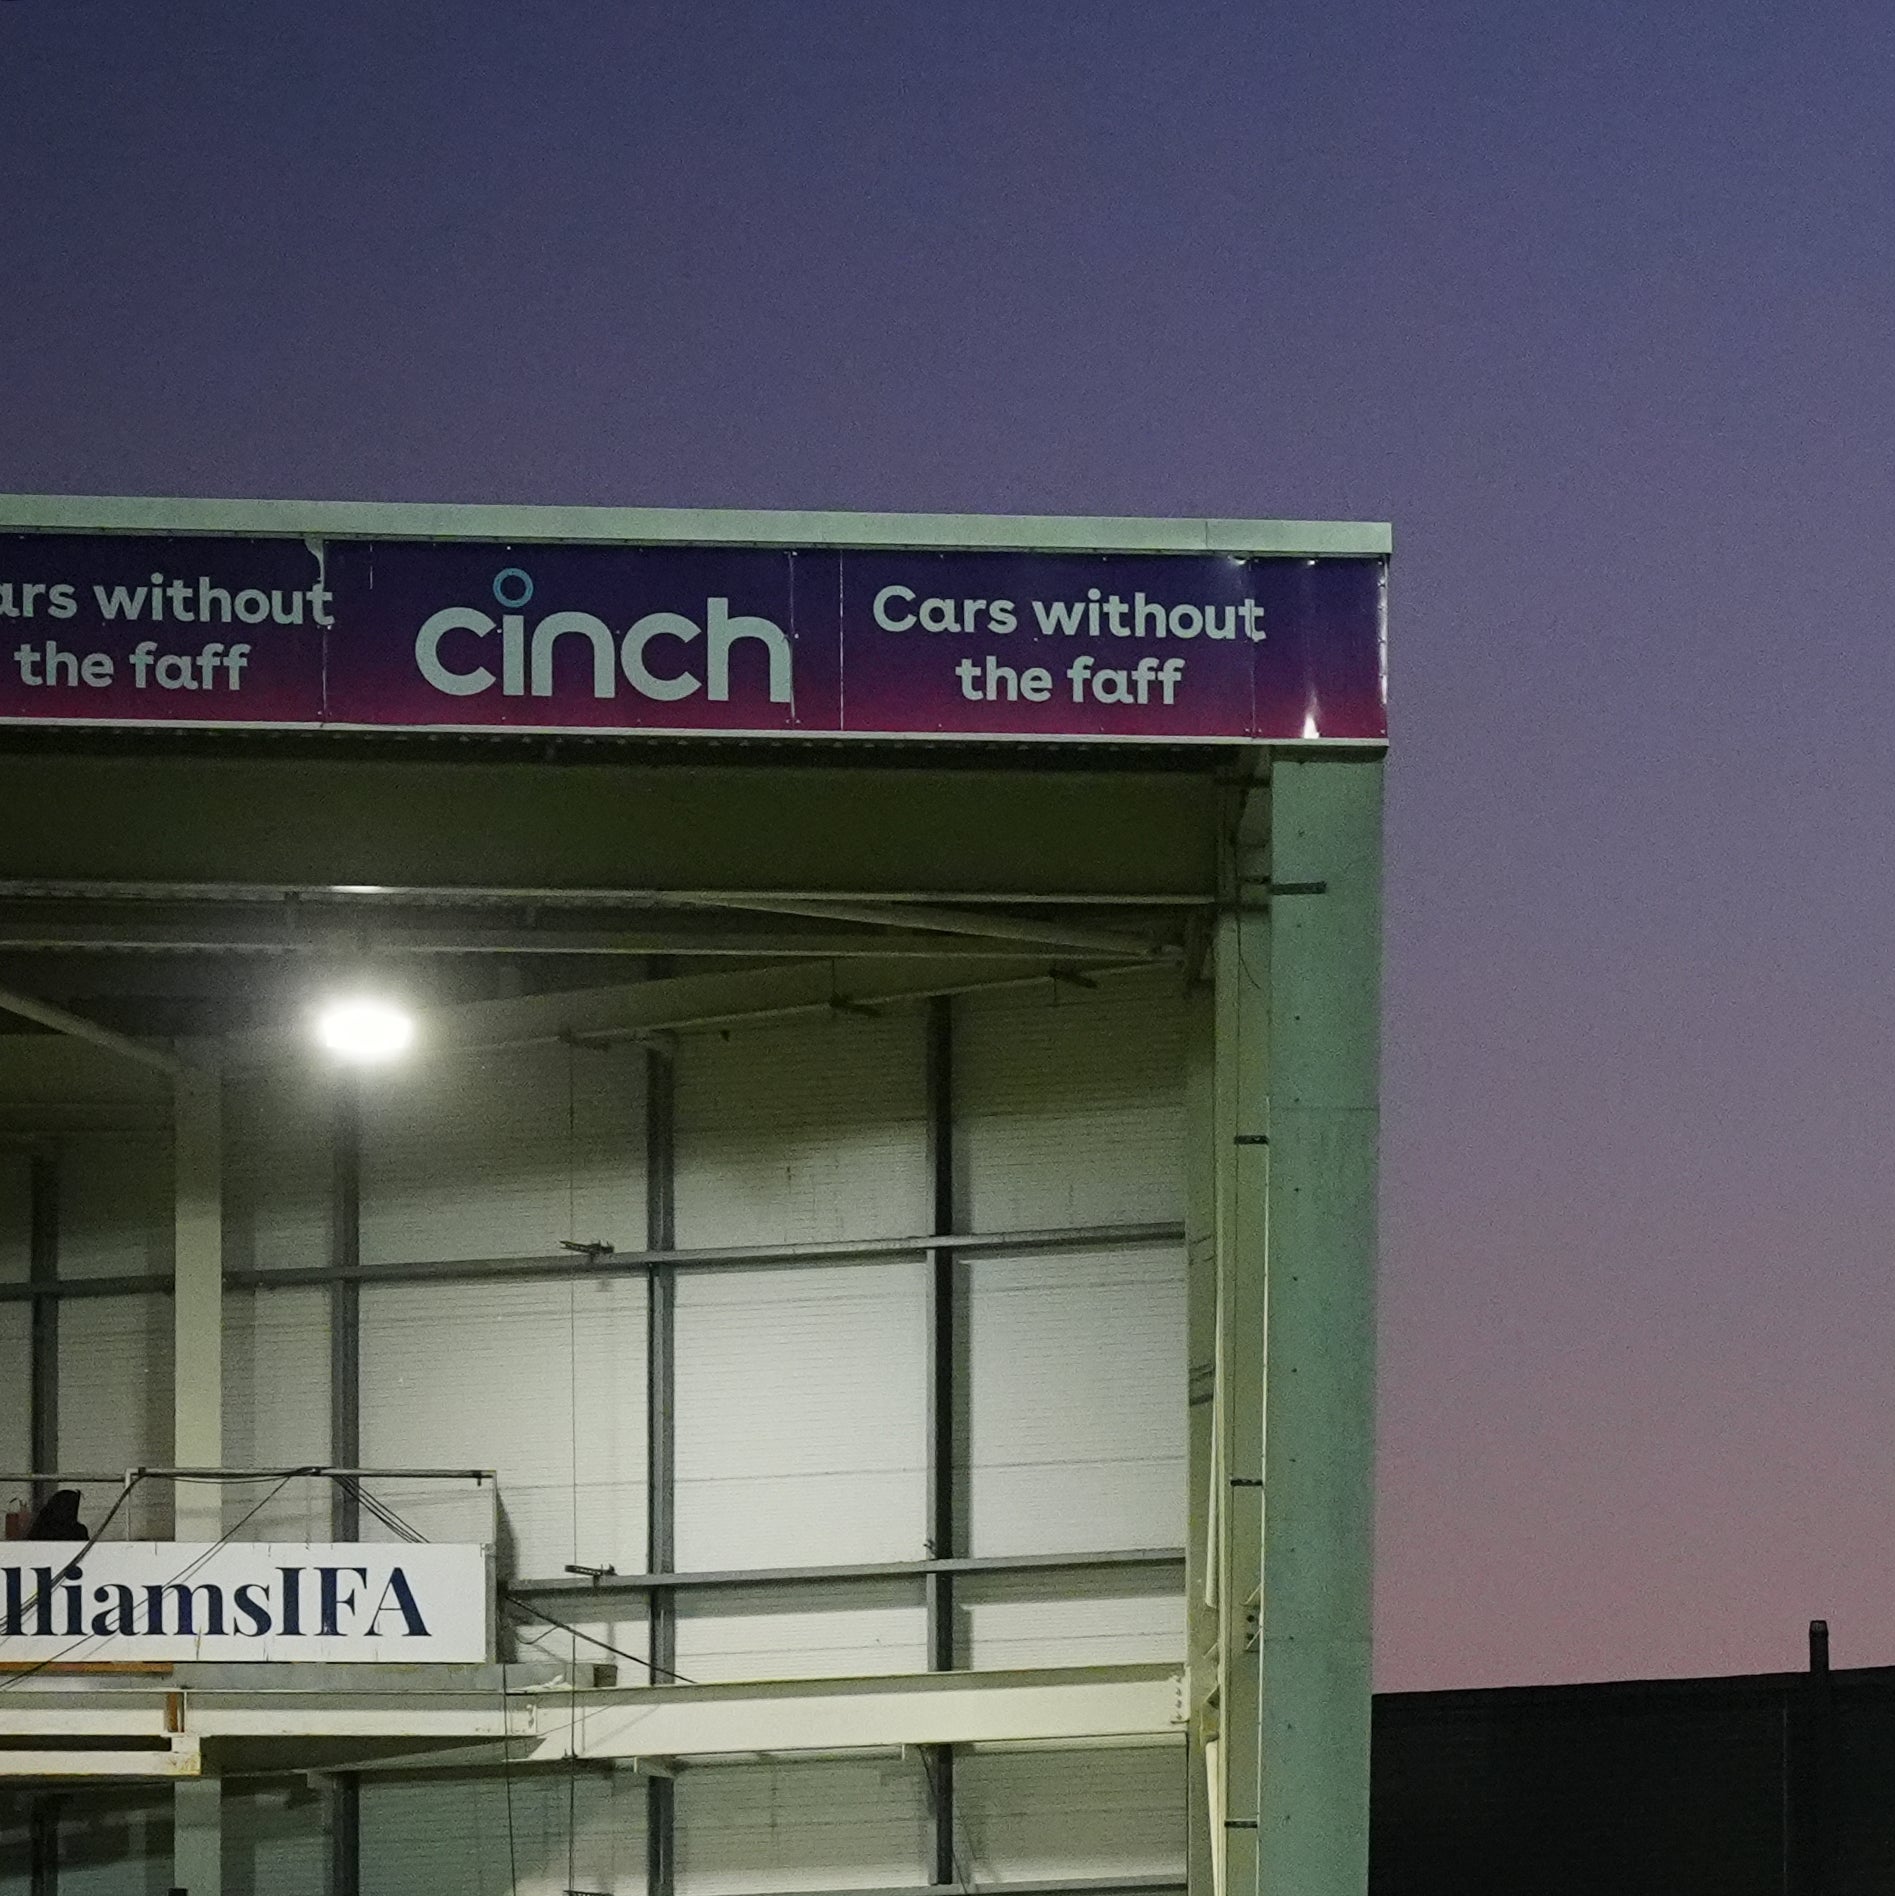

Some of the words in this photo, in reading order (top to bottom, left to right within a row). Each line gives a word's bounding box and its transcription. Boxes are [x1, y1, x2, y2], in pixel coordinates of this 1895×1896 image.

[92, 572, 334, 626] without
[872, 585, 1018, 634] Cars
[1032, 588, 1267, 642] without
[414, 567, 791, 703] cinch
[14, 641, 115, 688] the
[129, 642, 252, 691] faff
[955, 656, 1052, 702] the
[1067, 657, 1186, 705] faff
